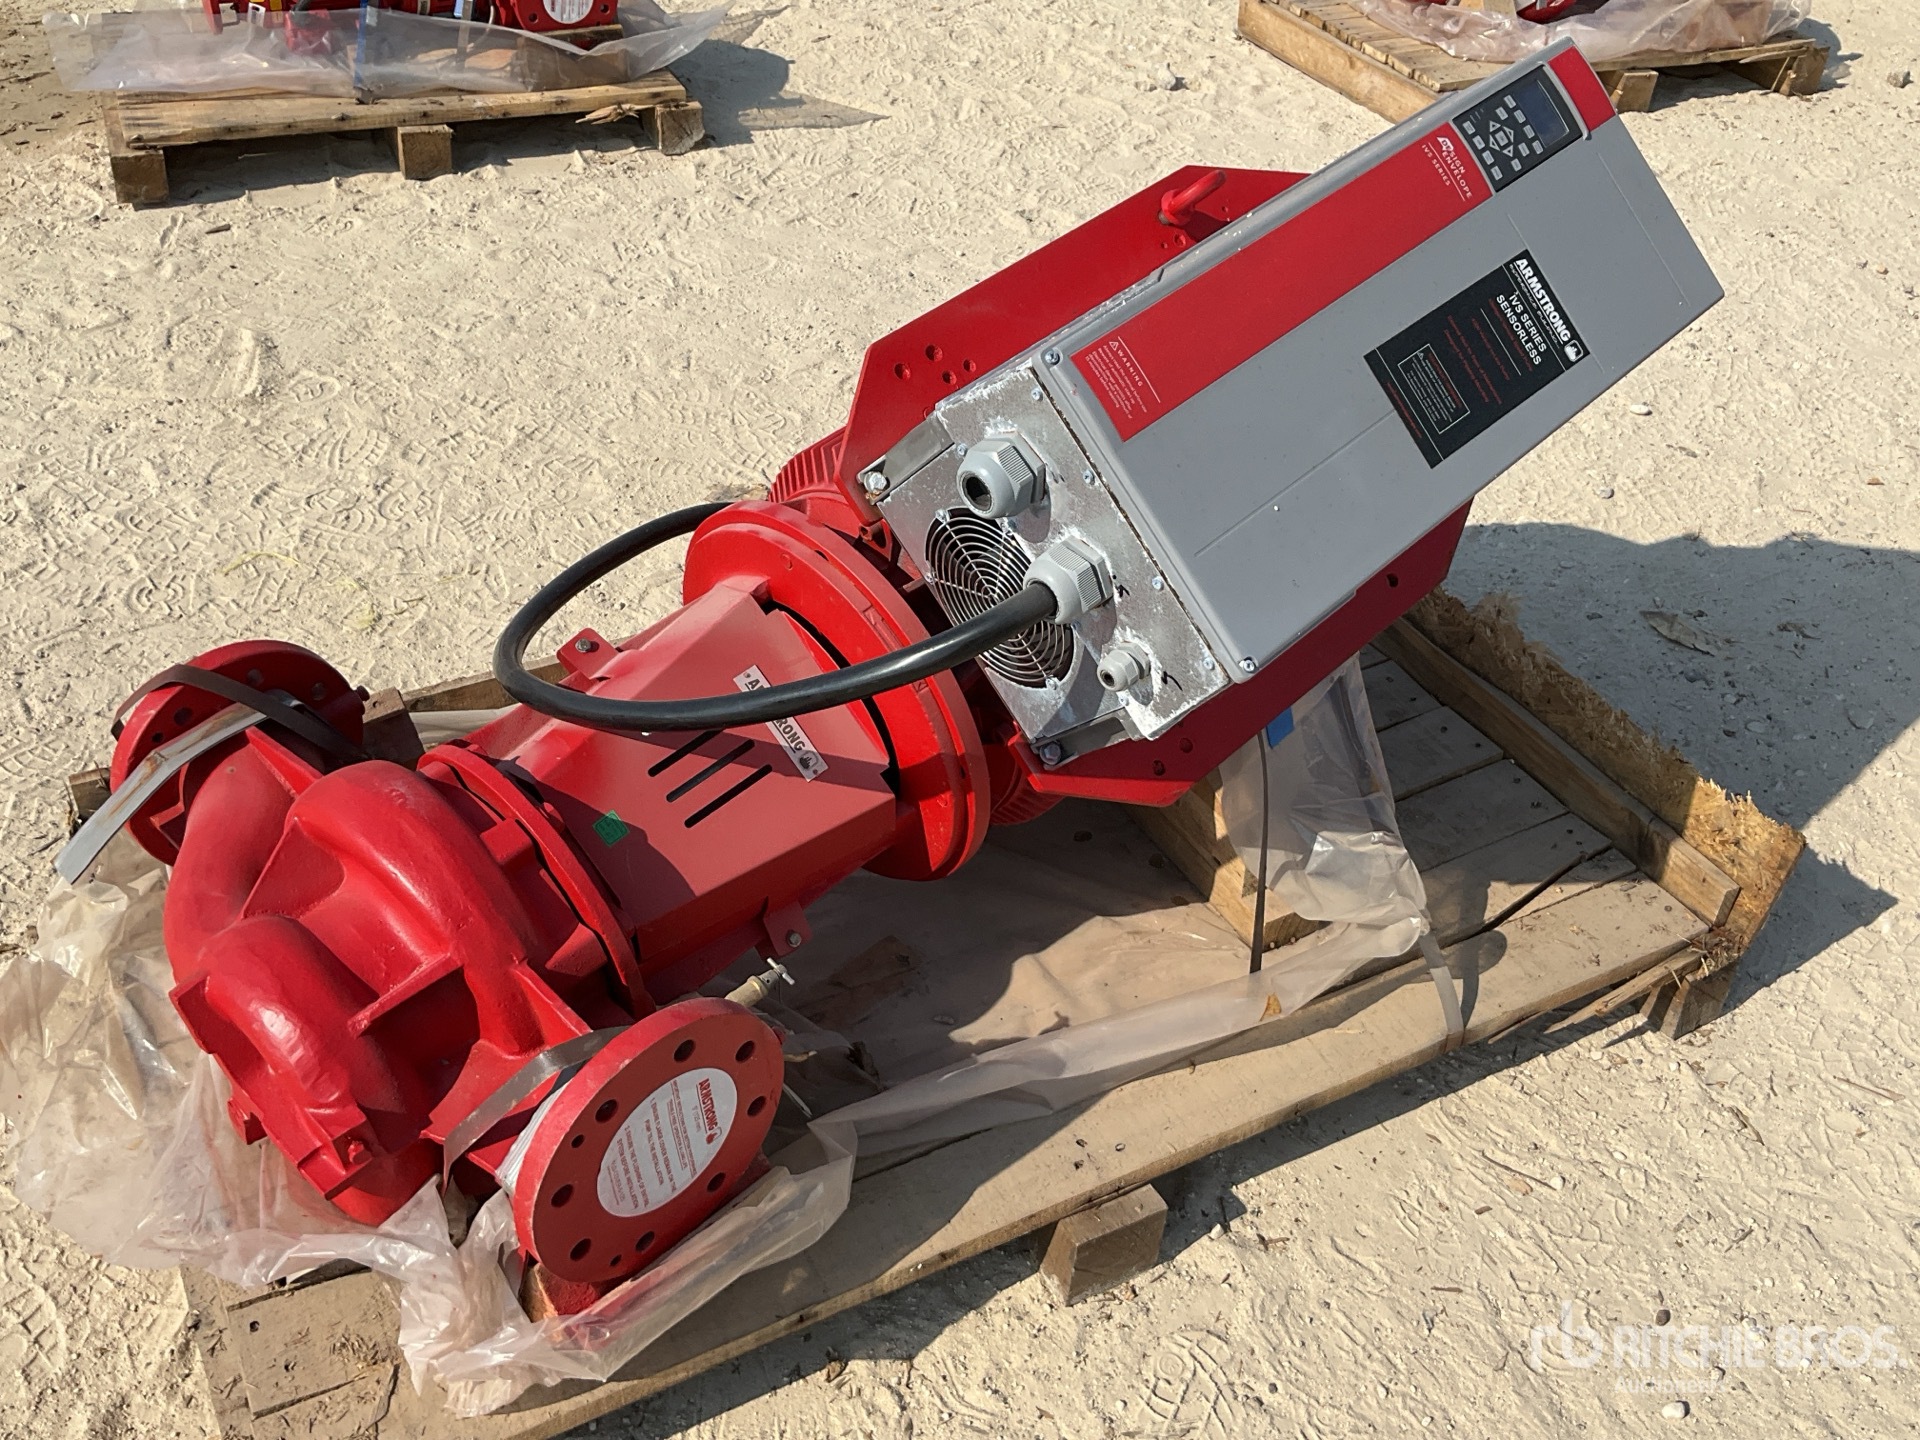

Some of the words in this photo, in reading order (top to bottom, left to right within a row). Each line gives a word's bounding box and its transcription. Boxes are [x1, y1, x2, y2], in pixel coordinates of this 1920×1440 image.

[1421, 143, 1432, 158] IVS
[1431, 158, 1451, 186] SERIES
[1441, 150, 1472, 198] ENVELOPE
[1514, 255, 1572, 342] ARMSTRONG
[1494, 293, 1542, 365] SENSORLESS
[1519, 312, 1547, 352] SERIES
[1116, 348, 1143, 387] WARNING
[1123, 375, 1135, 391] manual
[1132, 390, 1143, 405] before
[748, 679, 806, 751] ARONG
[699, 1078, 718, 1131] ARMSTRONG
